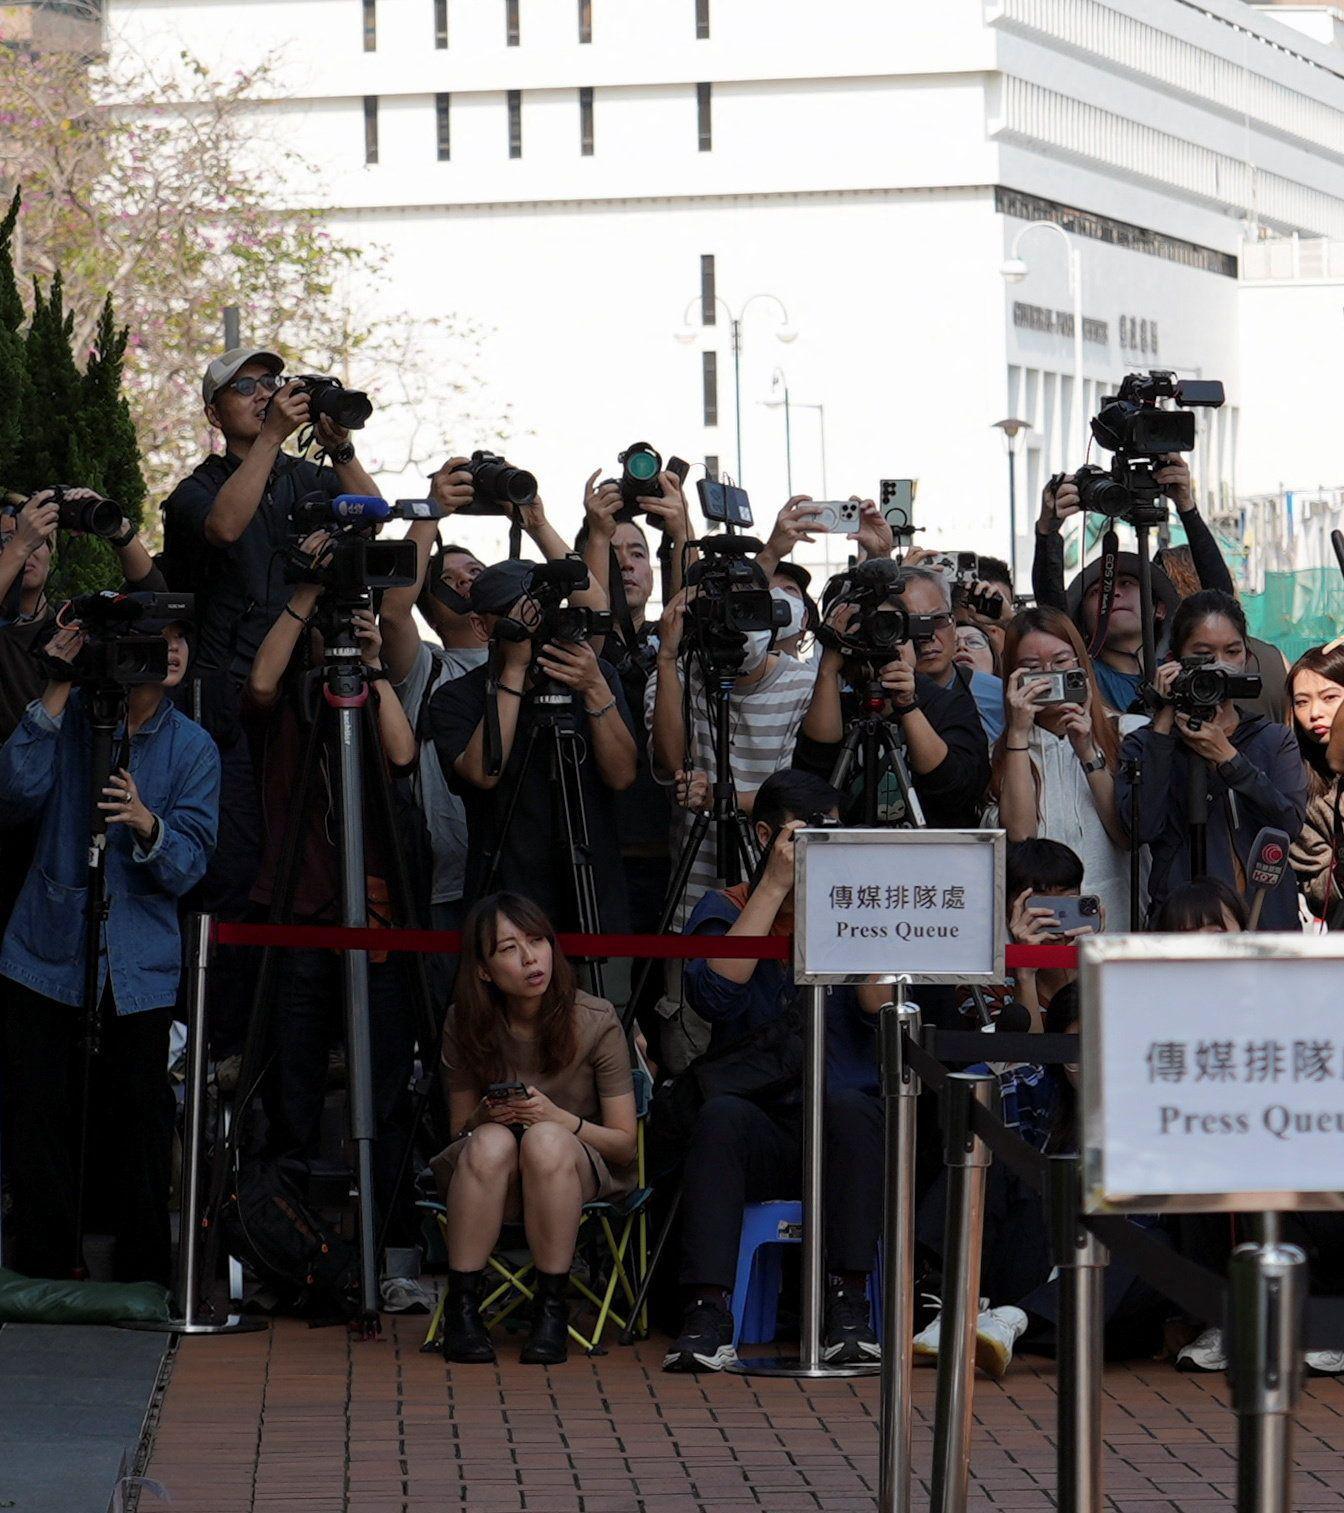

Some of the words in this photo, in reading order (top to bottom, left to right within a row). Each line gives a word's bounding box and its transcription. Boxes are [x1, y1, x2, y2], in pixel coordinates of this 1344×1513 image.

[1105, 553, 1115, 577] EOS
[829, 885, 965, 909] 傳媒排隊處
[836, 922, 888, 938] Press
[895, 921, 960, 941] Queue
[1159, 1105, 1250, 1134] Press
